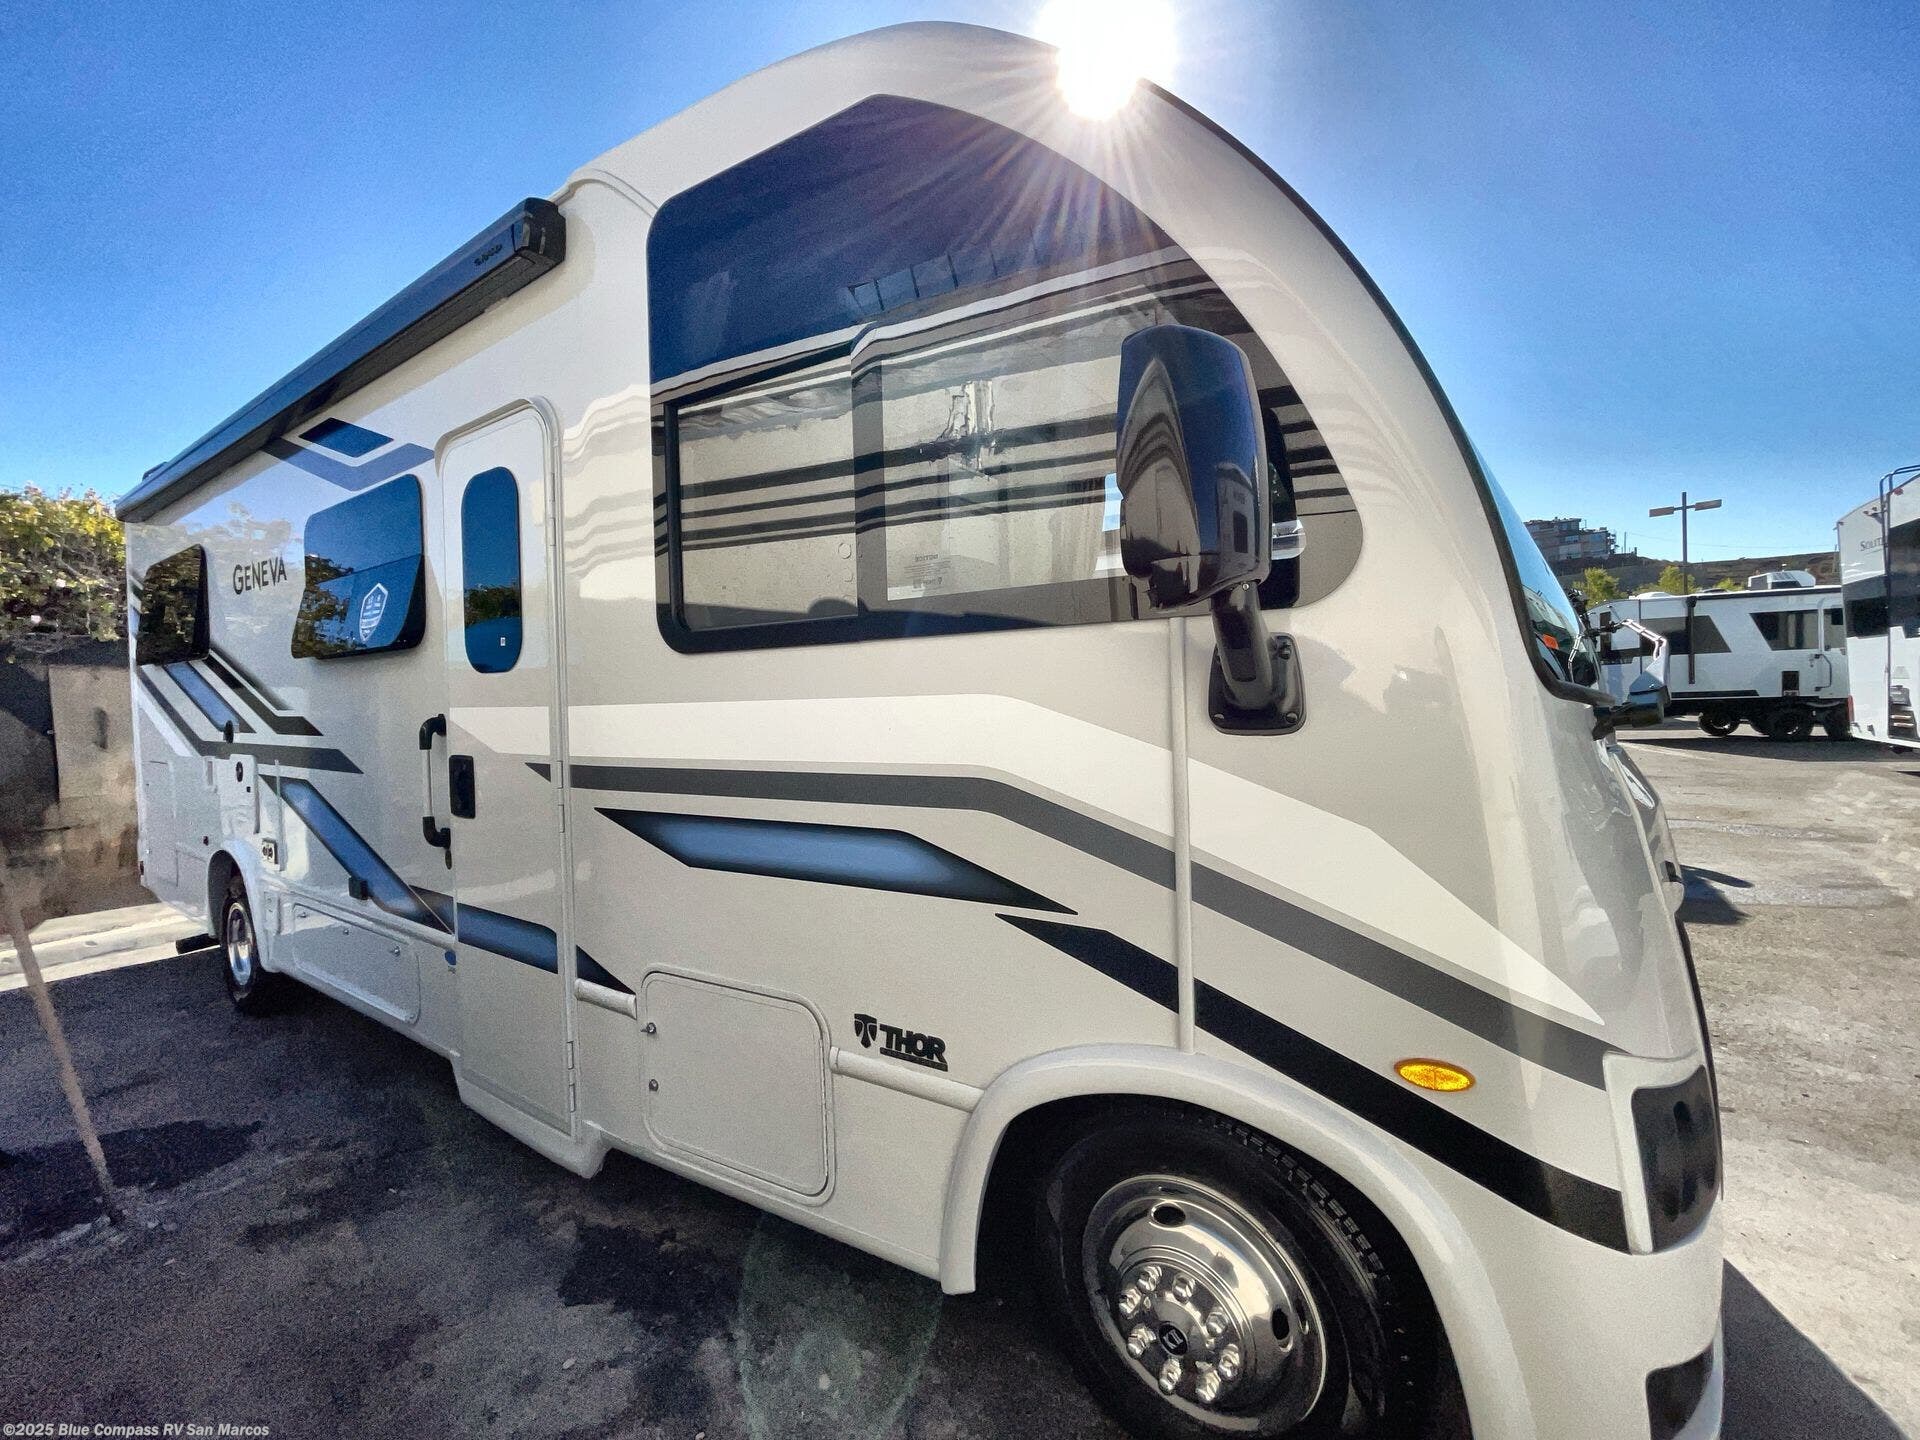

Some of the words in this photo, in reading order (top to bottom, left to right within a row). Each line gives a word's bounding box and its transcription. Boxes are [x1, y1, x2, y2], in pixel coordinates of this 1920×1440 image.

[1860, 536, 1882, 551] SOLIT
[232, 555, 288, 594] GENEVA
[879, 1023, 947, 1064] THOR
